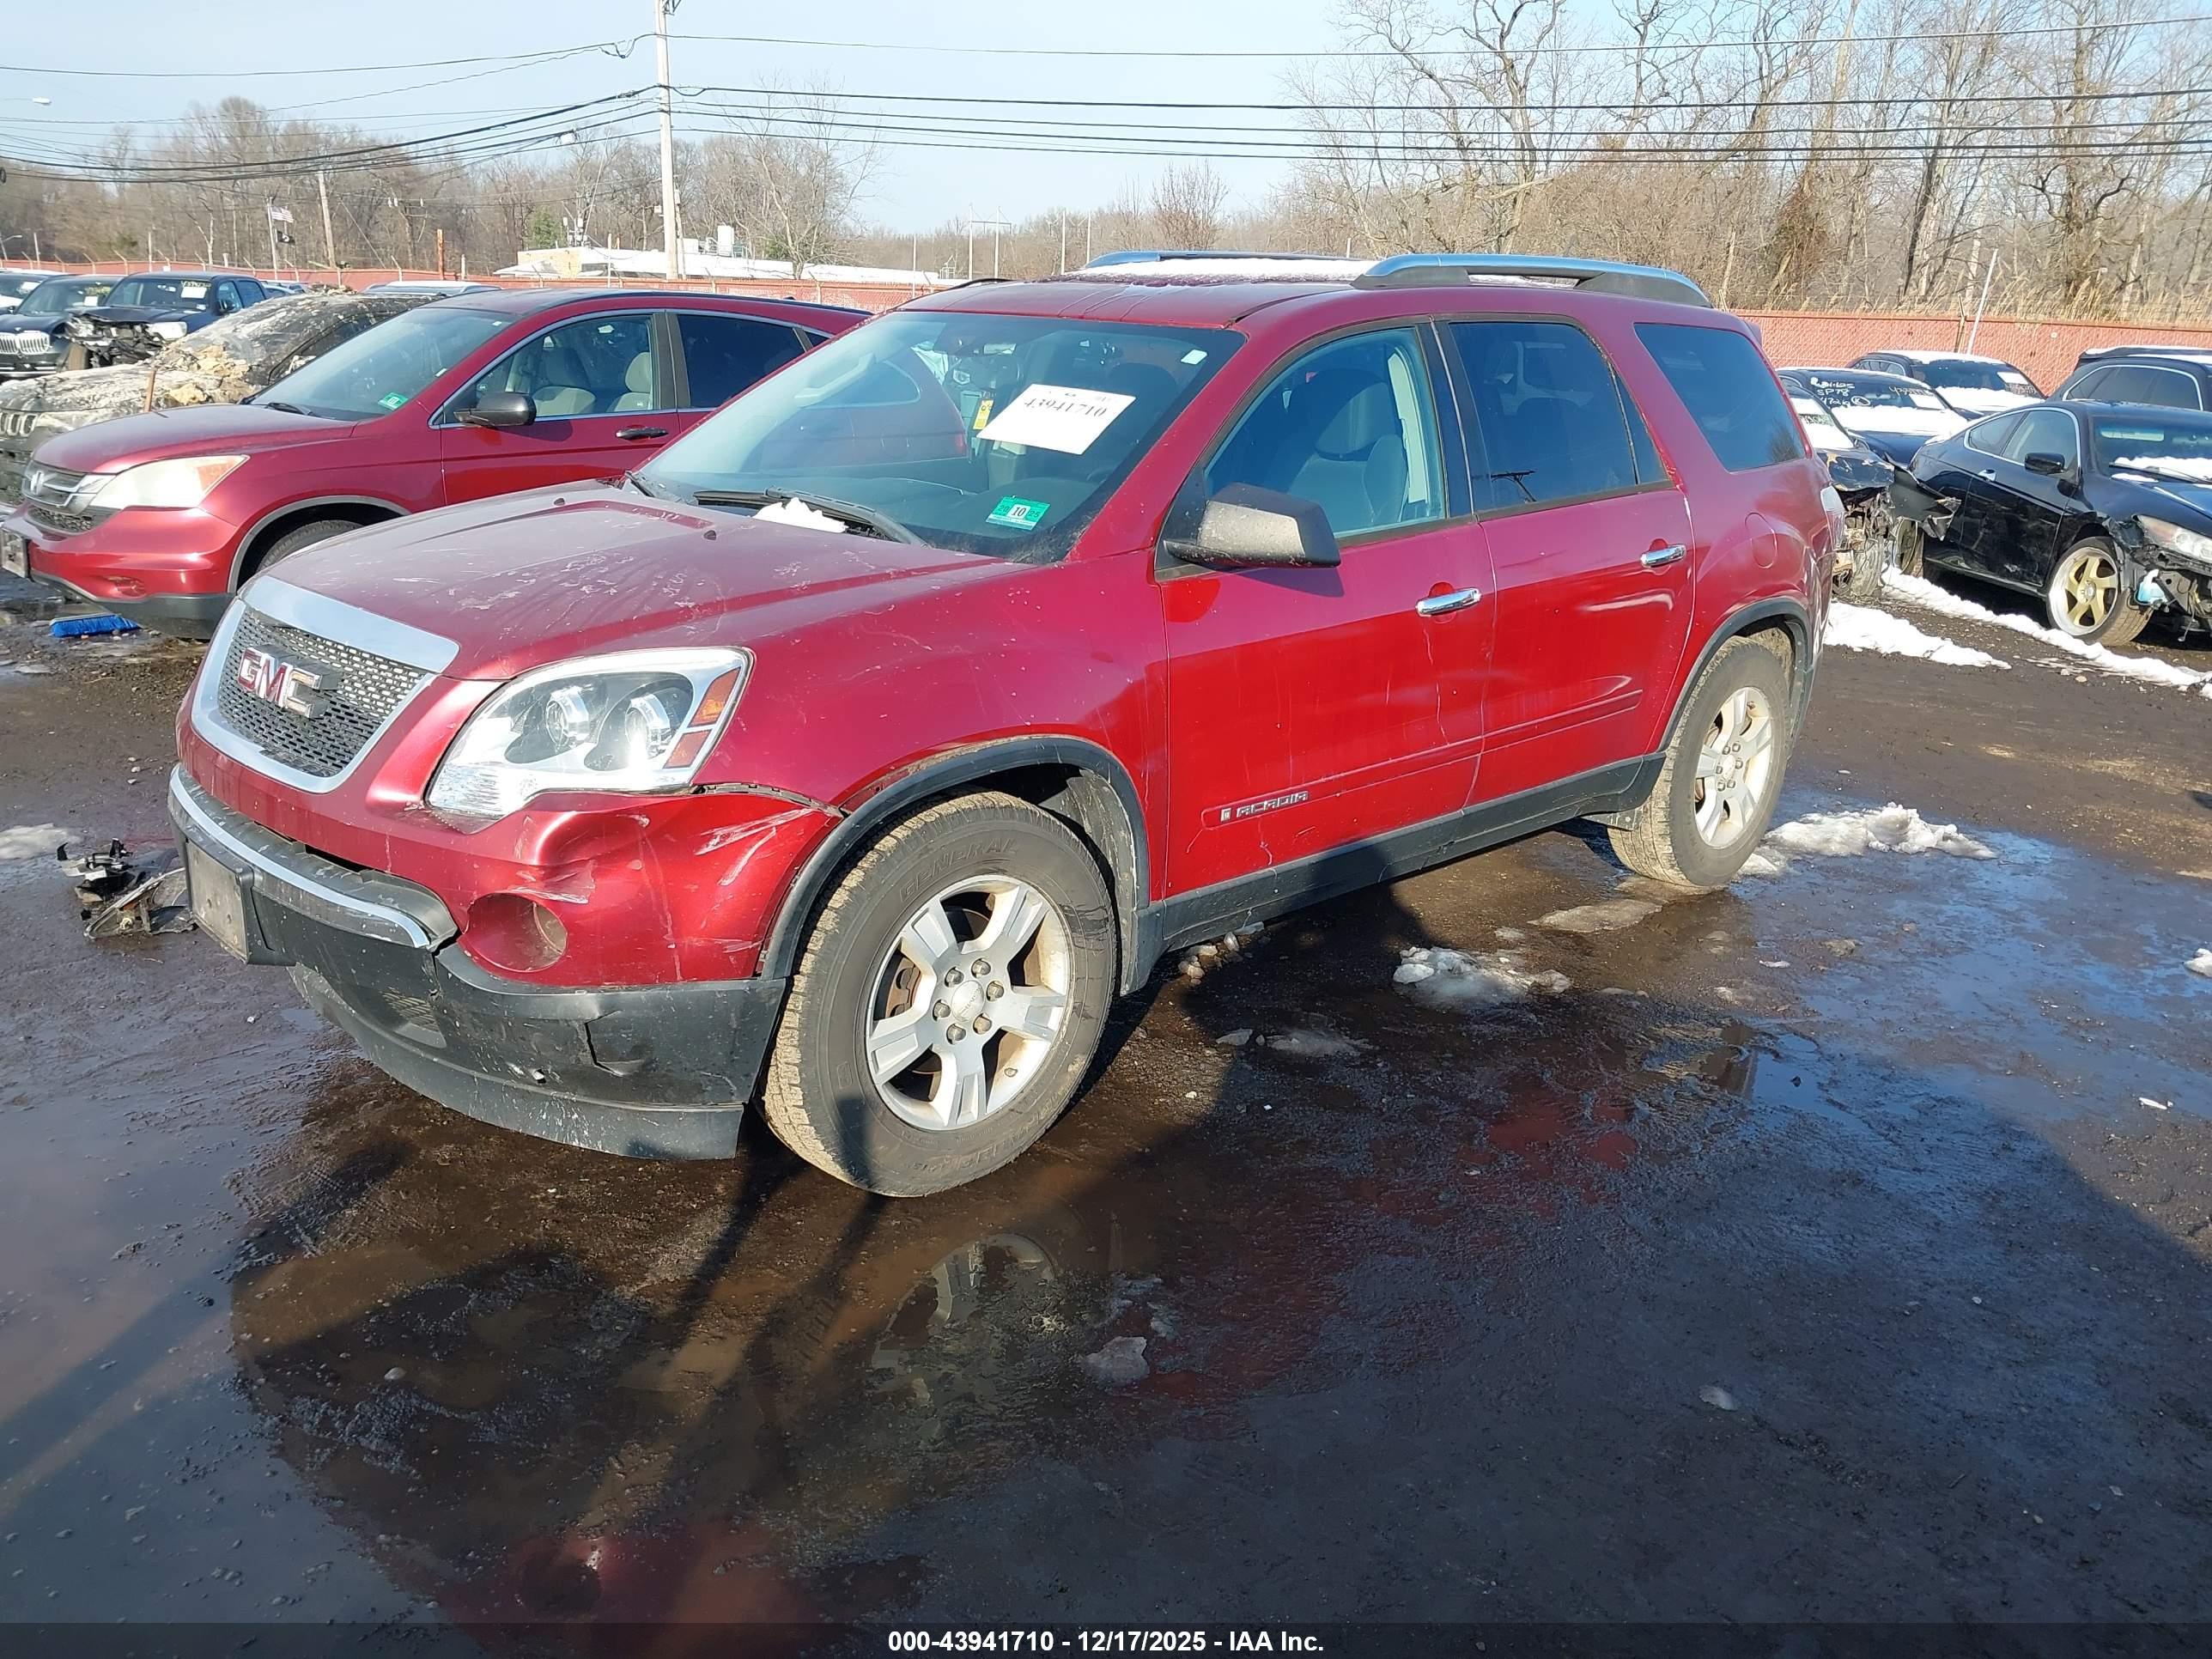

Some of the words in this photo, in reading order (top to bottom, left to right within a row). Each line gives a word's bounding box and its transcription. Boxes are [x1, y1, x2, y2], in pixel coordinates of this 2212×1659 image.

[1012, 507, 1027, 517] 10
[237, 647, 323, 718] GMC
[1237, 790, 1309, 818] ACADIA
[899, 836, 1018, 902] GENERAL
